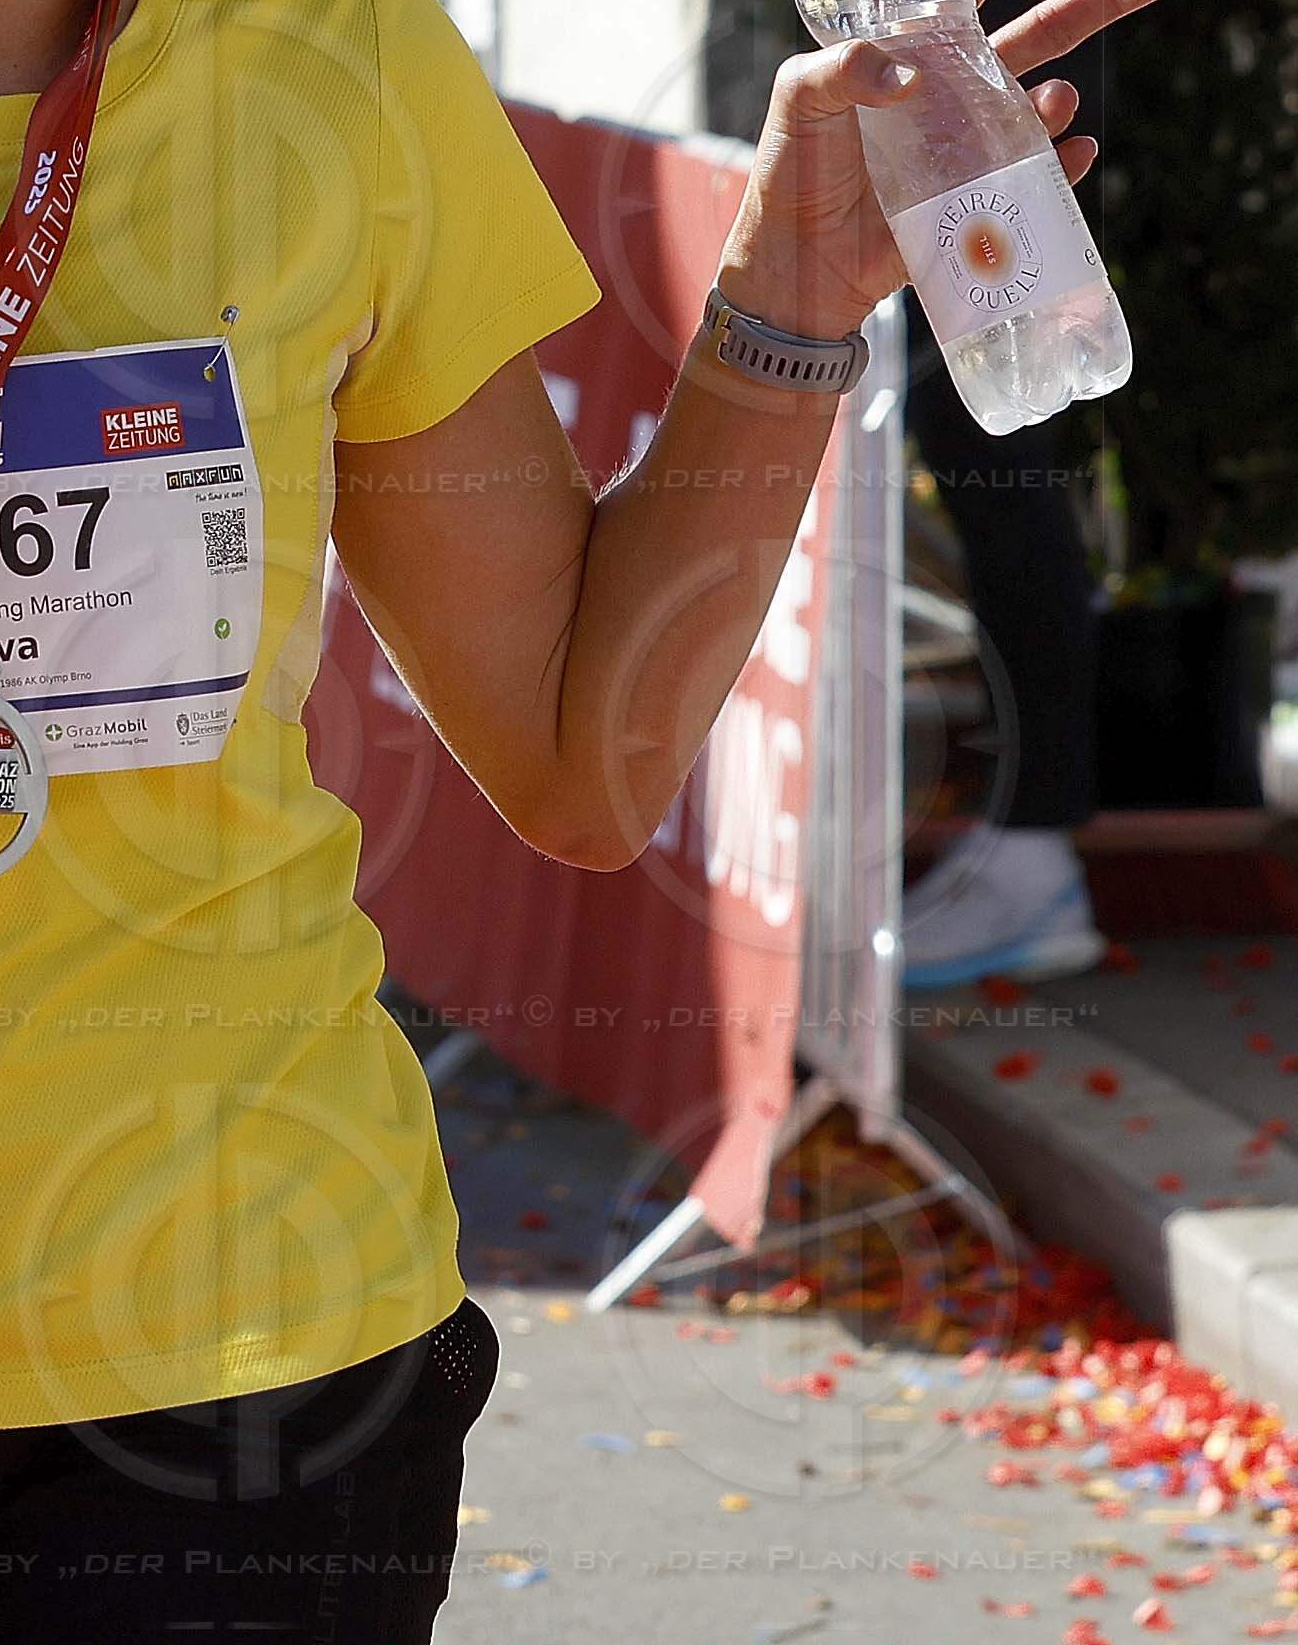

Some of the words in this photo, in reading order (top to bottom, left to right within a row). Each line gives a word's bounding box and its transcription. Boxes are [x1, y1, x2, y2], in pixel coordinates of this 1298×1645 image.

[25, 150, 57, 215] 2025
[15, 135, 85, 287] ZEITUNG
[938, 192, 1022, 248] STEIRER
[969, 267, 1041, 309] QUELL
[106, 407, 179, 431] KLEINE
[107, 426, 181, 450] ZEITUNG
[31, 590, 133, 615] Marathon
[0, 677, 23, 688] 1986
[25, 676, 37, 685] AK
[71, 672, 92, 682] Brno
[193, 711, 209, 722] Das
